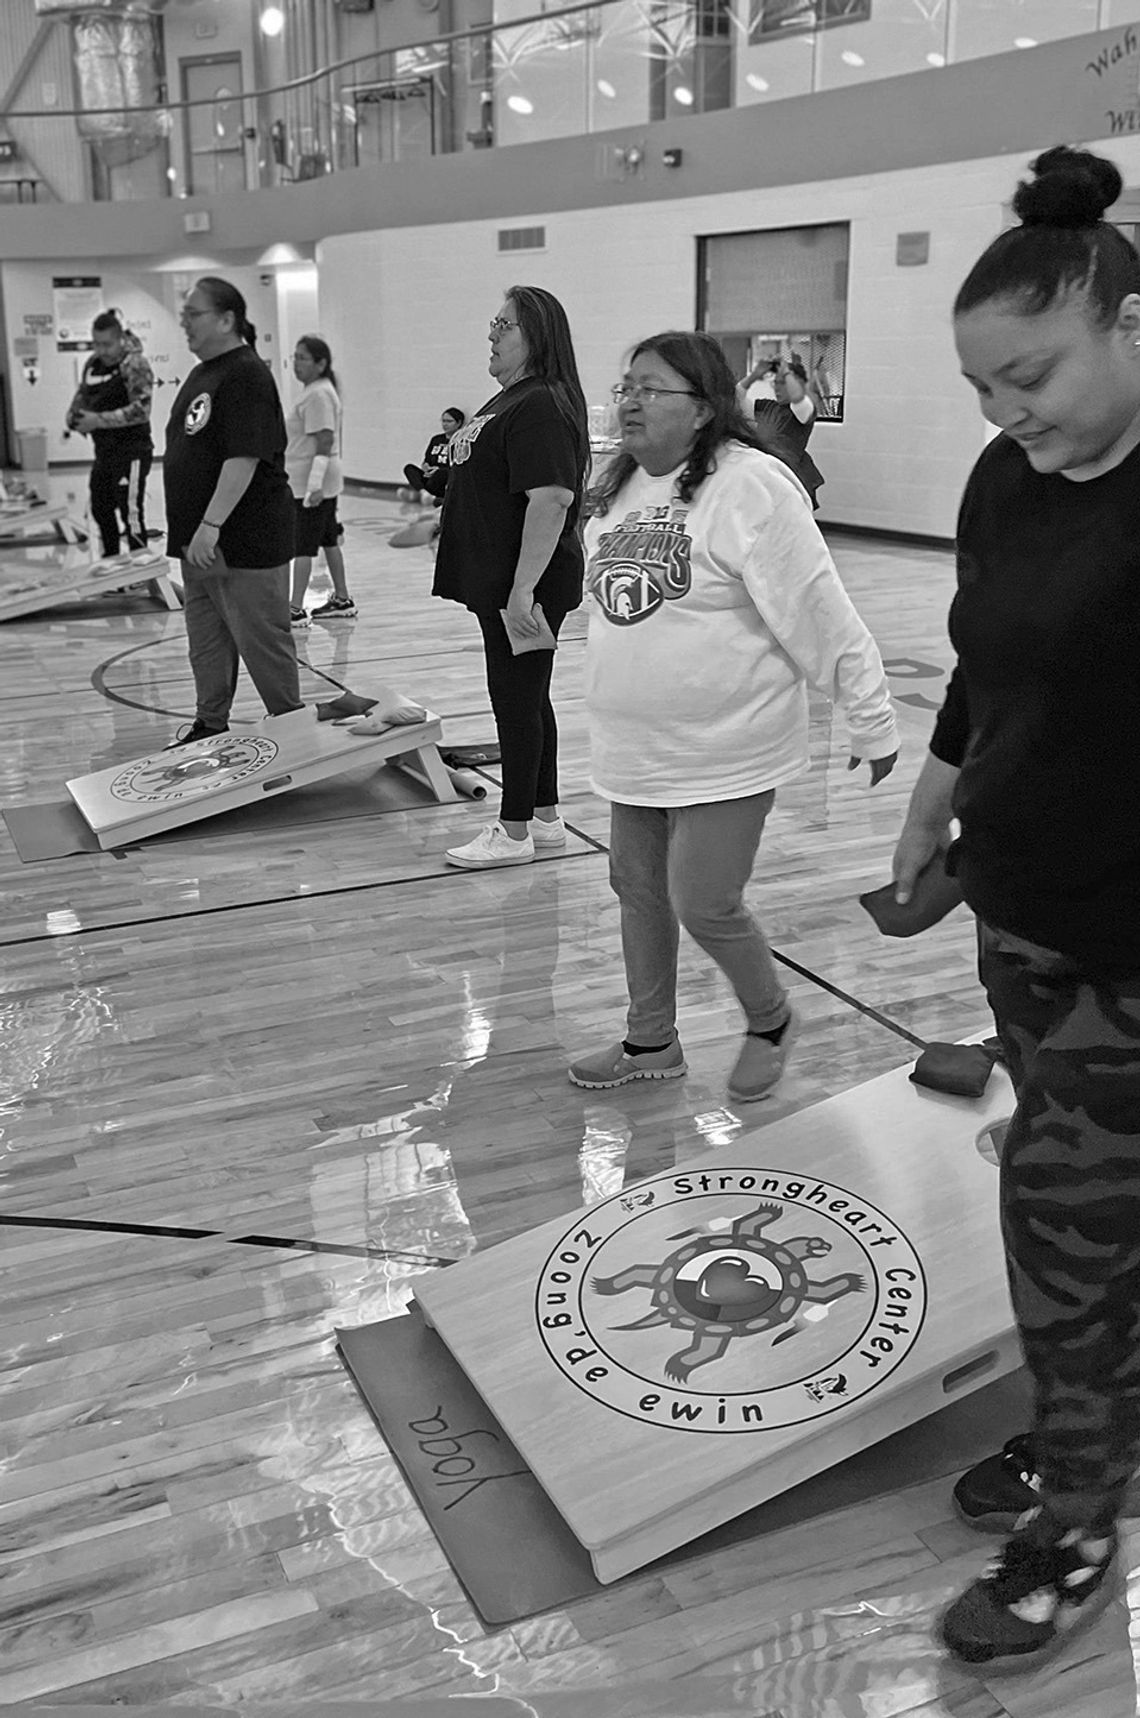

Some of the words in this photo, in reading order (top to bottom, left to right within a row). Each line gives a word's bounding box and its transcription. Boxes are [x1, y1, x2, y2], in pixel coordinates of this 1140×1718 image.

[673, 1176, 897, 1249] Strongheart
[859, 1267, 917, 1369] Center
[408, 1404, 532, 1511] Yoga
[639, 1393, 764, 1424] ewin
